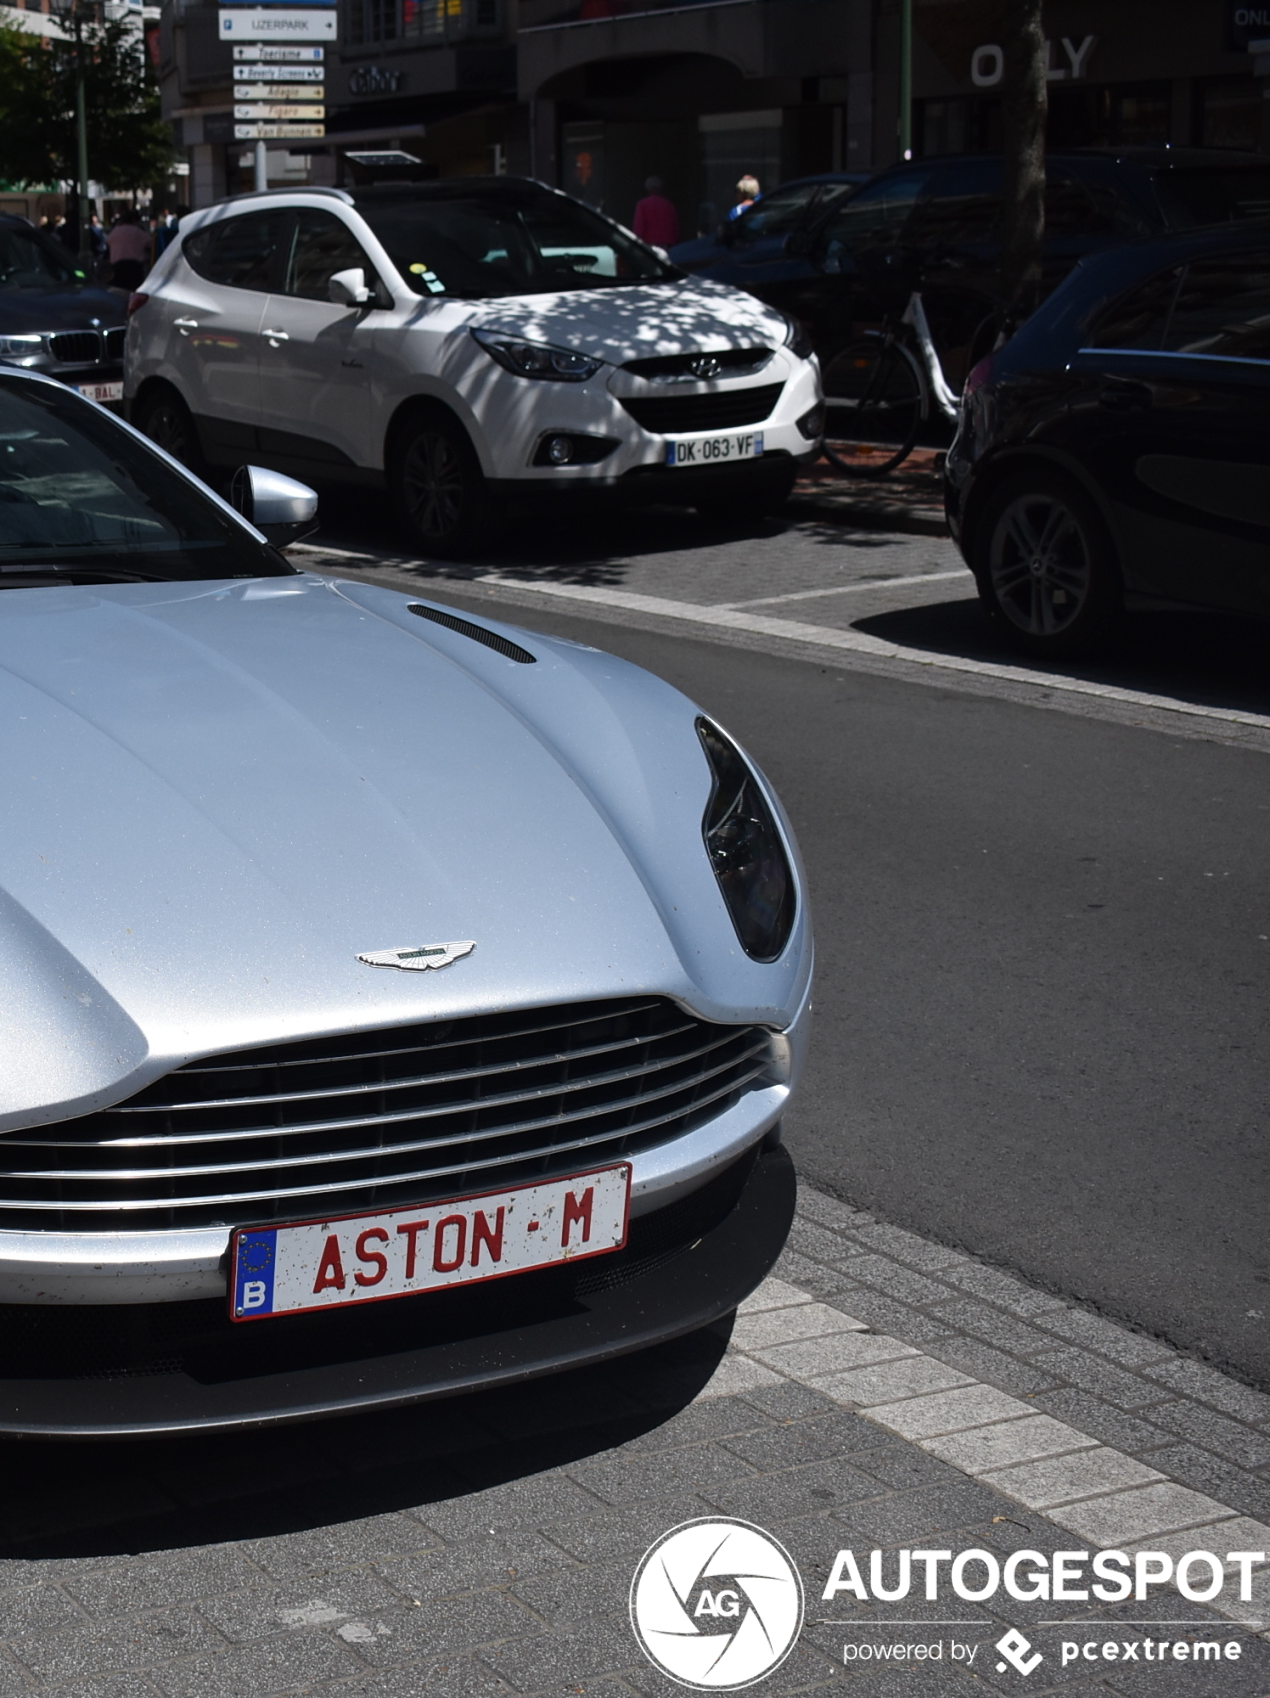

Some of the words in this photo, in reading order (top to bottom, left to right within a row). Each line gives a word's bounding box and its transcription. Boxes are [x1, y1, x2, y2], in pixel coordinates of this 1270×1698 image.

[259, 48, 301, 59] Toerisme
[971, 35, 1094, 86] OLY
[268, 86, 299, 99] Adagio
[242, 1280, 267, 1309] B
